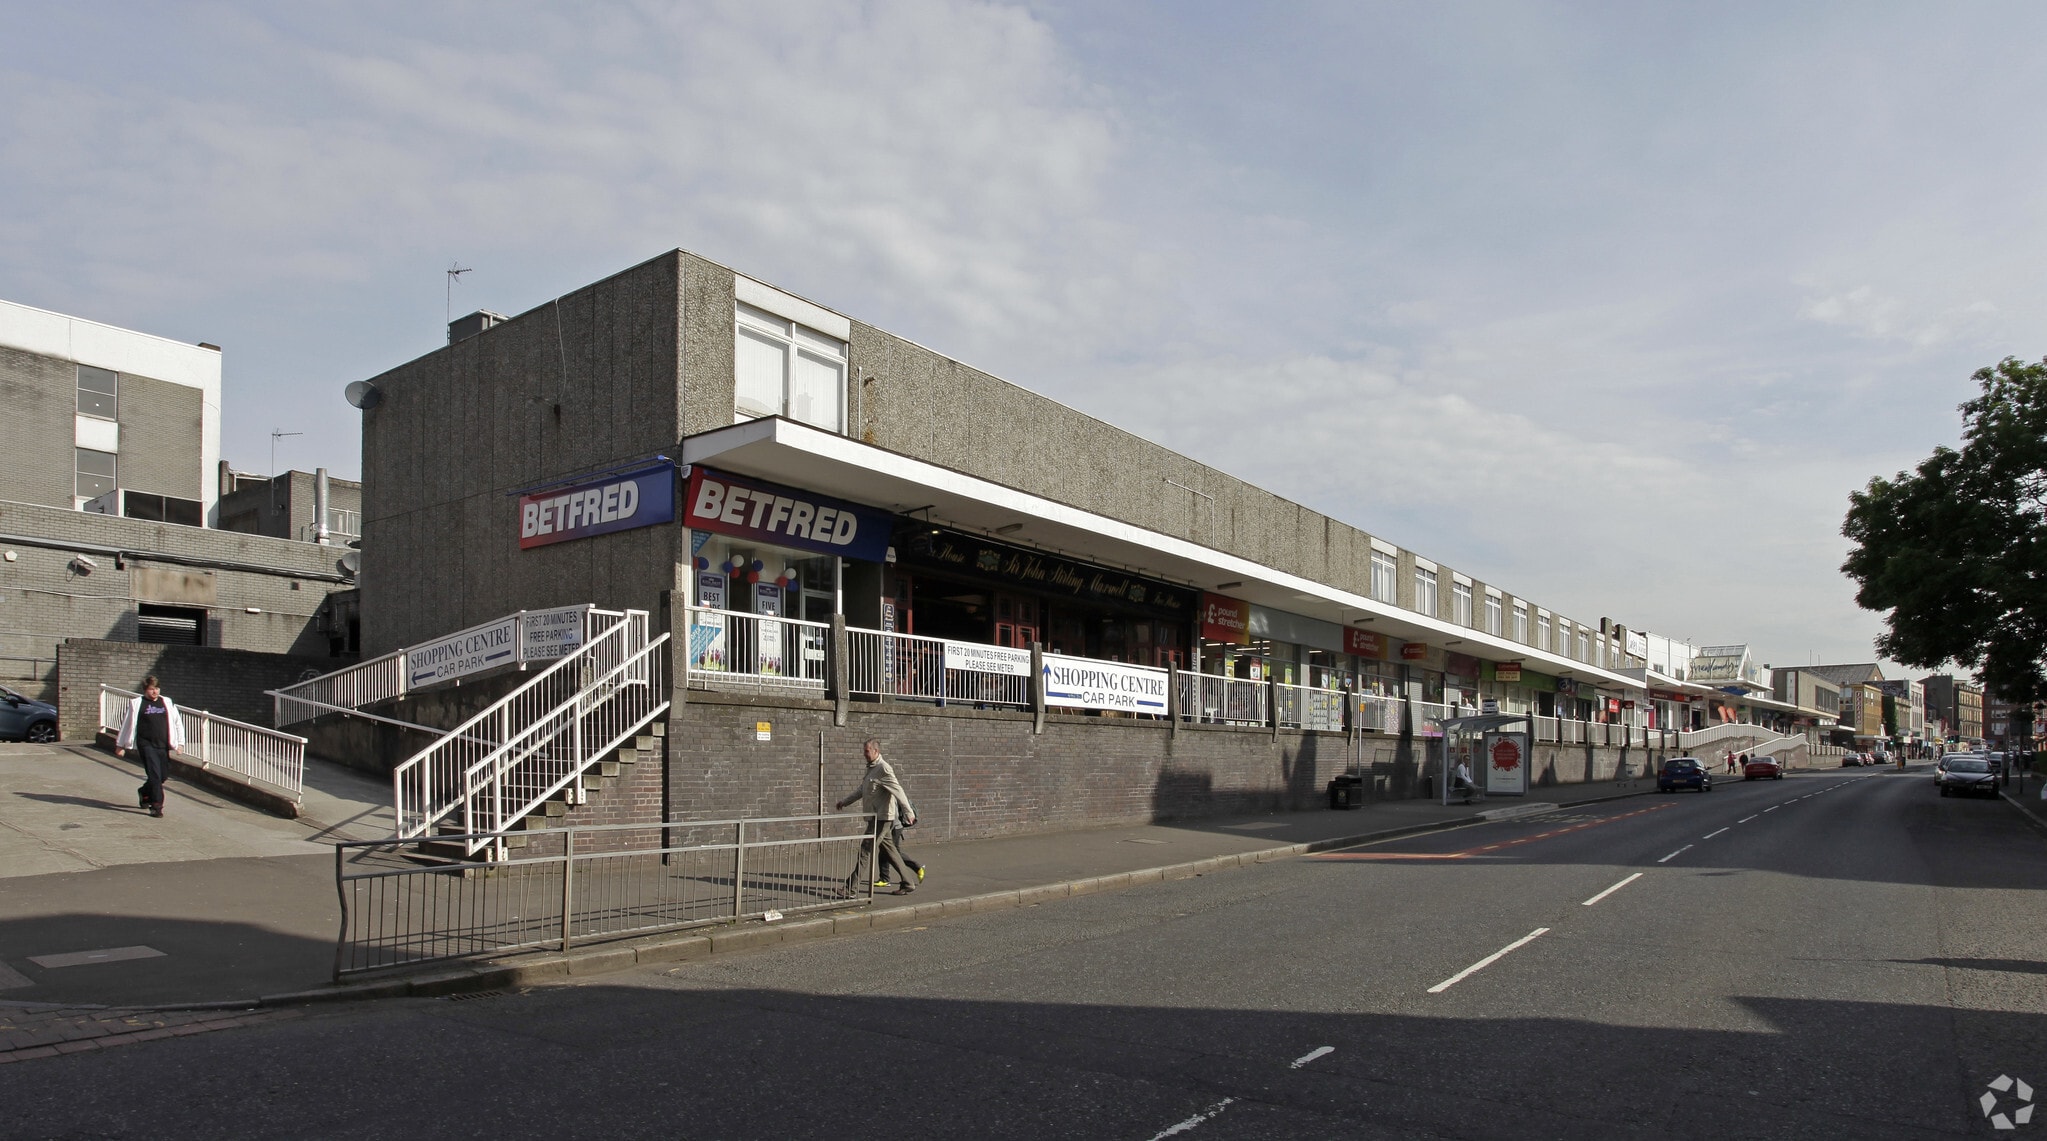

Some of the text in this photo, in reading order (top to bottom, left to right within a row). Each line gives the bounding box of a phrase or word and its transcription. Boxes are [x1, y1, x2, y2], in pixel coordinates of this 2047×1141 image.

[521, 480, 639, 539] BETFRED
[692, 479, 858, 546] BETFRED
[1002, 553, 1020, 575] Sir
[1019, 555, 1046, 581] John
[1088, 573, 1130, 596] Maxwell
[703, 591, 720, 602] BEST
[761, 600, 776, 610] FIVE
[526, 610, 578, 627] FIRST 20 MINUTES
[1218, 607, 1238, 618] pound
[1218, 616, 1246, 630] stretcher
[529, 627, 573, 643] FREE PARKING
[410, 625, 511, 671] SHOPPING CENTRE
[523, 645, 546, 658] PLEASE
[546, 644, 558, 657] SEE
[947, 645, 1030, 664] FIRST 20 MINUTES FREE PARKING
[436, 654, 485, 678] CAR PARK
[965, 659, 1015, 673] PLEASE SEE METER
[1053, 666, 1118, 691] SHOPPING
[1120, 674, 1165, 696] CENTRE
[1082, 691, 1105, 705] CAR
[1108, 693, 1136, 708] PARK
